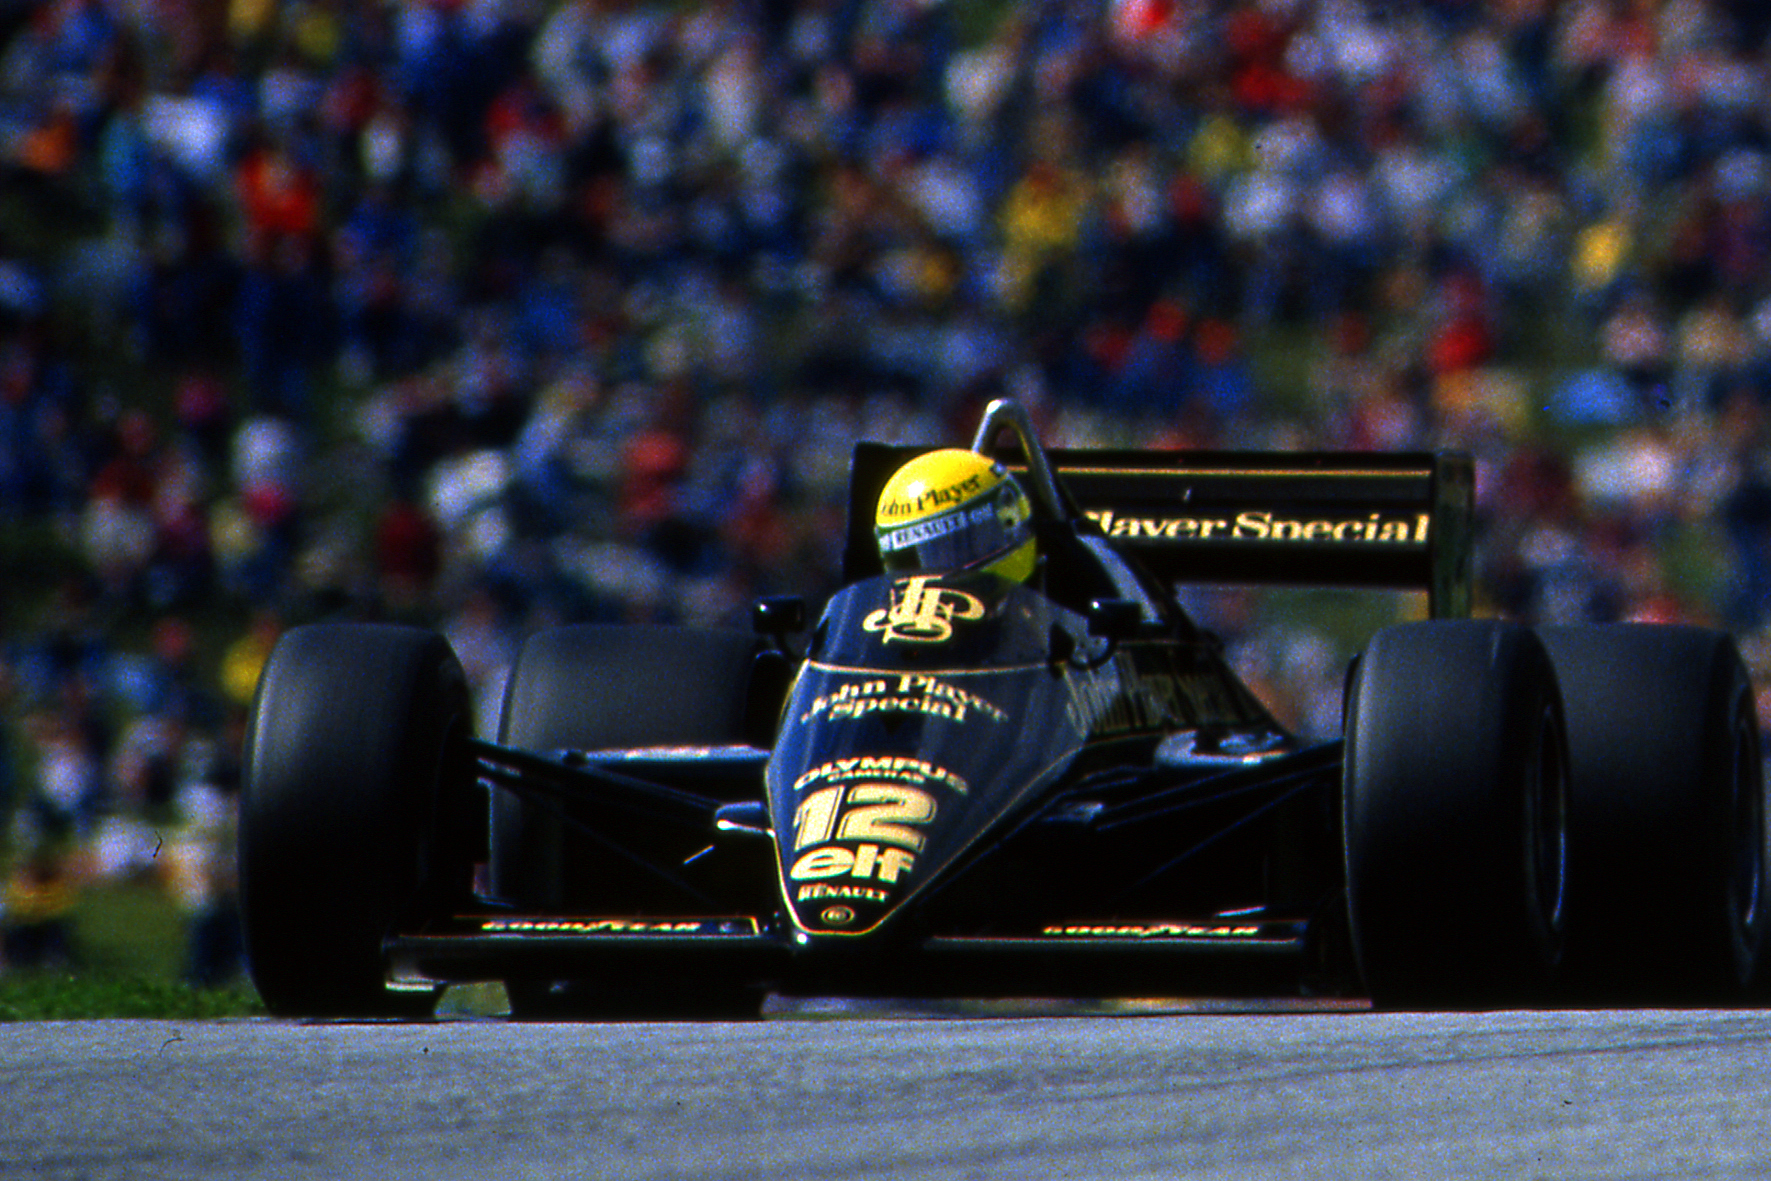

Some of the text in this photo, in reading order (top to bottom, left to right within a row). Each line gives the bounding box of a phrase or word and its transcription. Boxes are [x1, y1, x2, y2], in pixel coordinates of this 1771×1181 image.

[916, 474, 981, 512] Player
[1232, 511, 1430, 543] Special
[801, 674, 1010, 724] John Player
[828, 695, 967, 724] Special
[793, 755, 970, 797] OLYMPUS
[826, 769, 926, 787] CAMERAS
[792, 783, 938, 856] 12
[789, 843, 915, 884] elf
[797, 882, 889, 903] RENAULT
[1042, 923, 1260, 937] GOODYEAR
